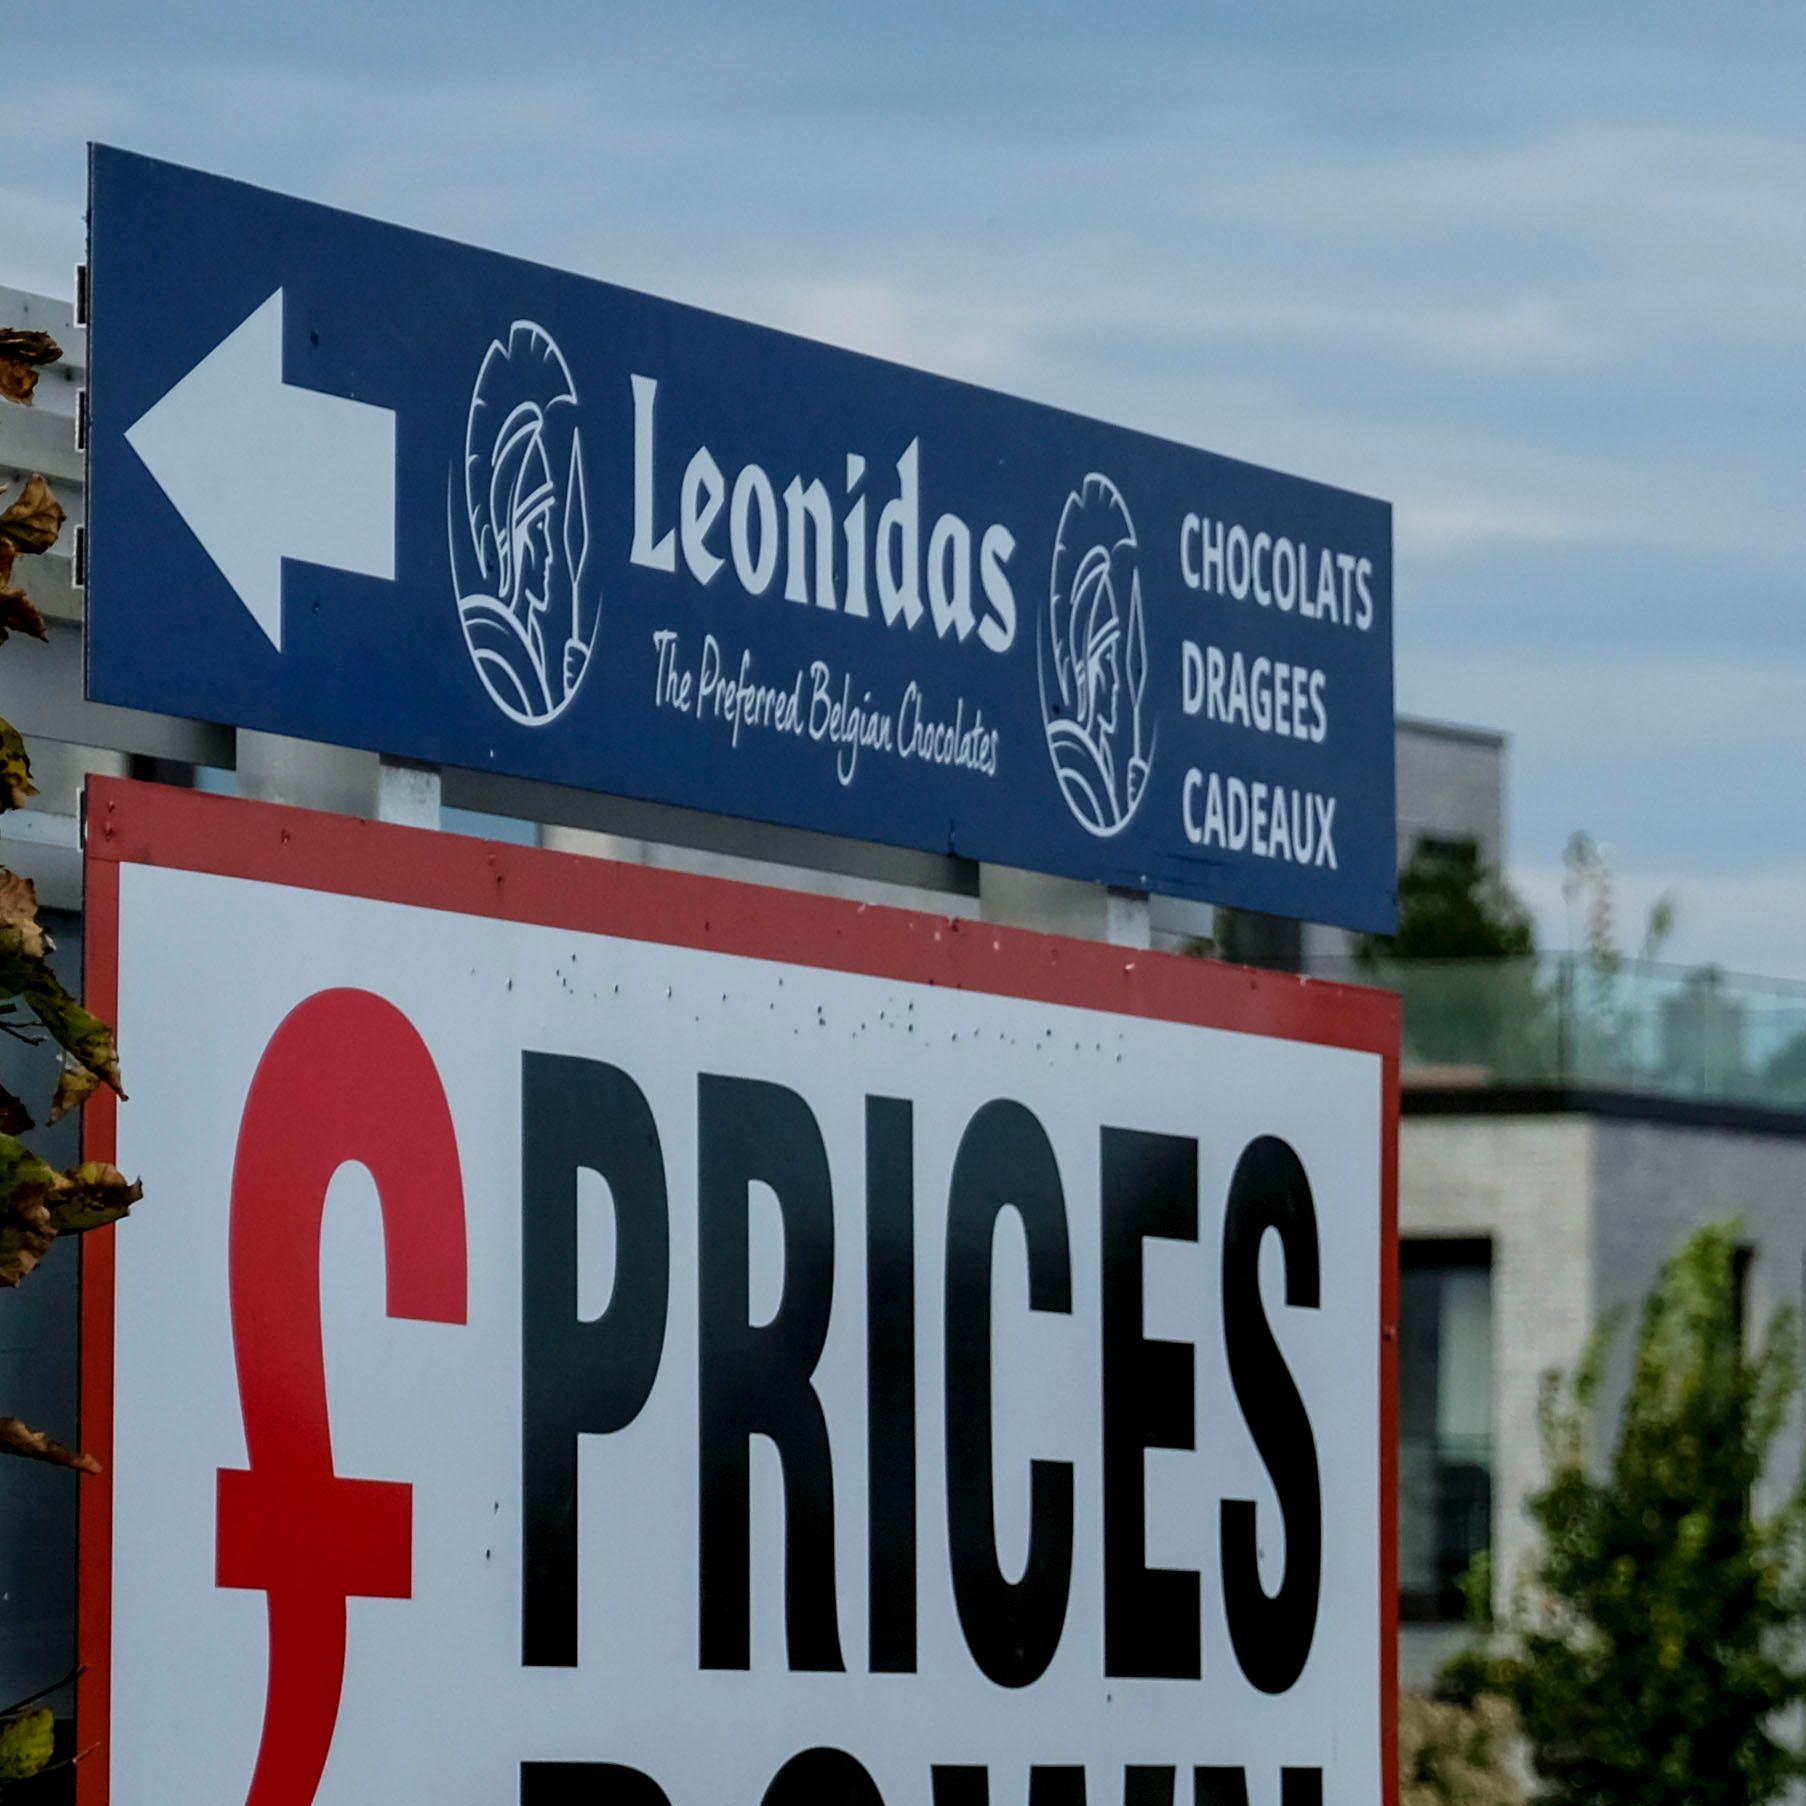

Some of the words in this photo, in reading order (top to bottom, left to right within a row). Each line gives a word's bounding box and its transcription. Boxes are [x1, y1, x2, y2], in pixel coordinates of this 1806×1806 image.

[631, 374, 1016, 652] Leonidas
[1181, 513, 1373, 630] CHOCOLATS
[653, 629, 691, 711] The
[696, 633, 804, 749] Preferred
[809, 660, 893, 786] Belgian
[897, 680, 998, 777] Chocolates
[1182, 640, 1327, 743] DRAGEES
[1183, 768, 1337, 869] CADEAUX
[522, 1049, 1322, 1695] PRICES
